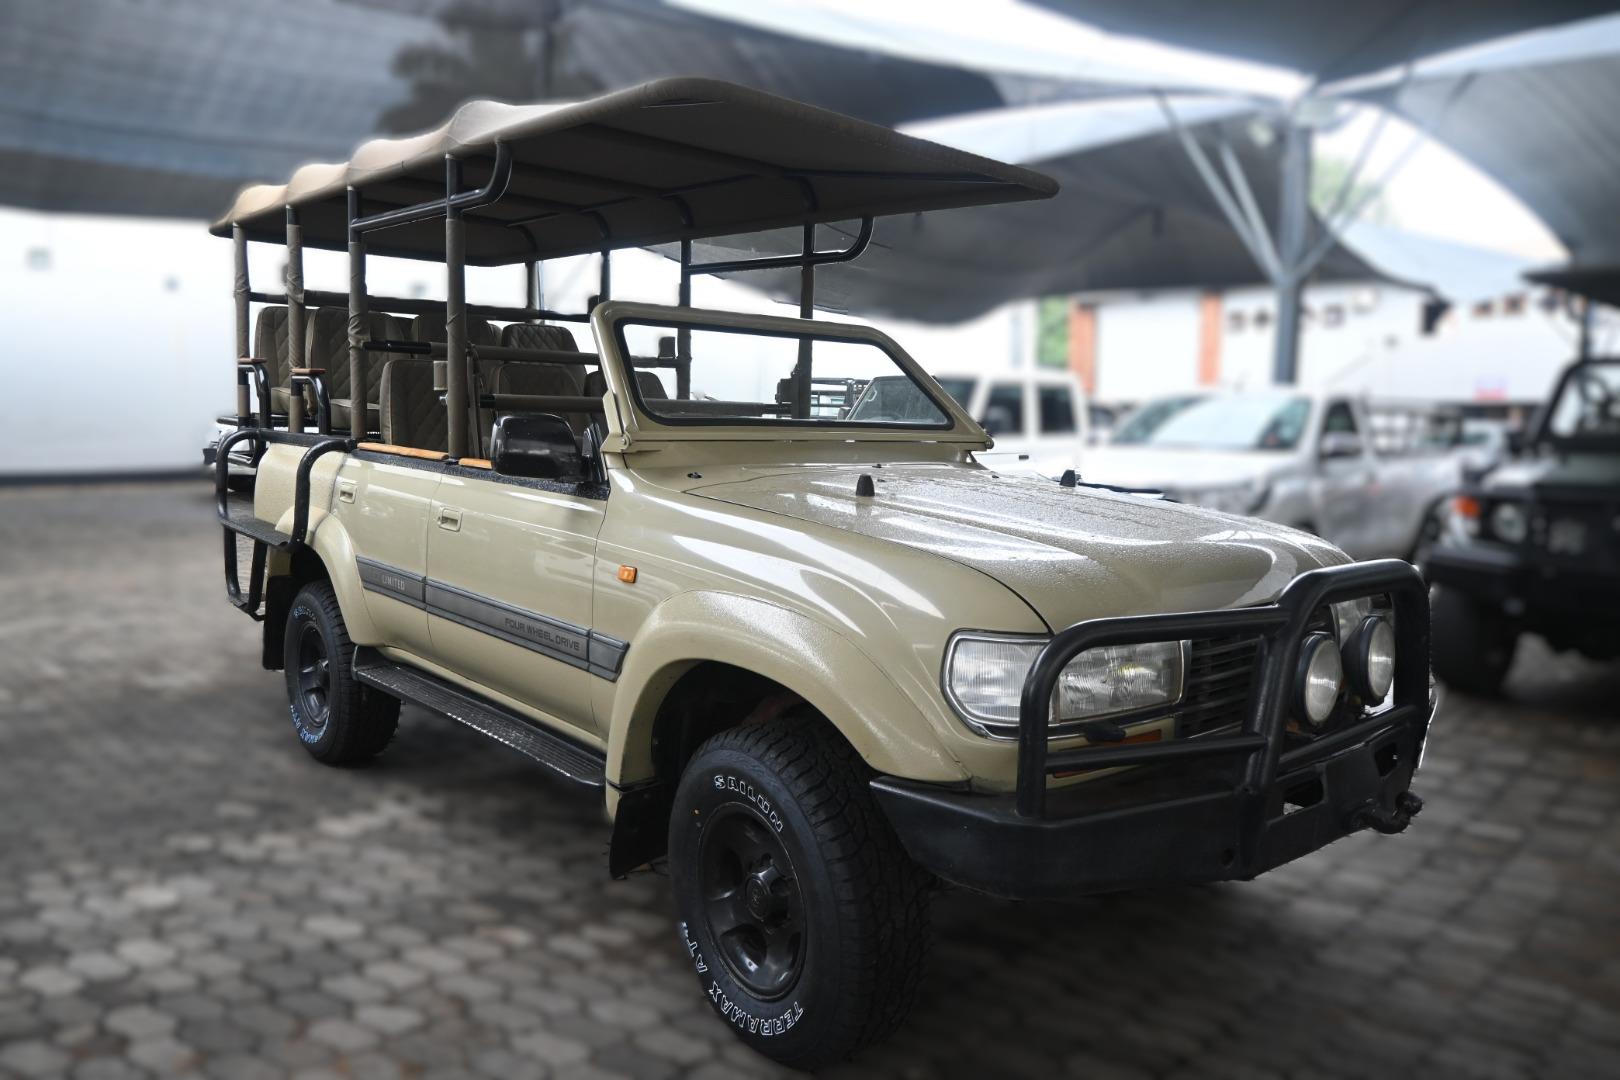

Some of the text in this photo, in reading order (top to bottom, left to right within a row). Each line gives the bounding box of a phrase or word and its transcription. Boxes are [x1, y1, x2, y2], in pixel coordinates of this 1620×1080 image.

[505, 618, 580, 651] FOUR WHEEL DRIVE
[714, 774, 783, 832] SAILUN
[708, 980, 803, 1036] TERRAMAX
